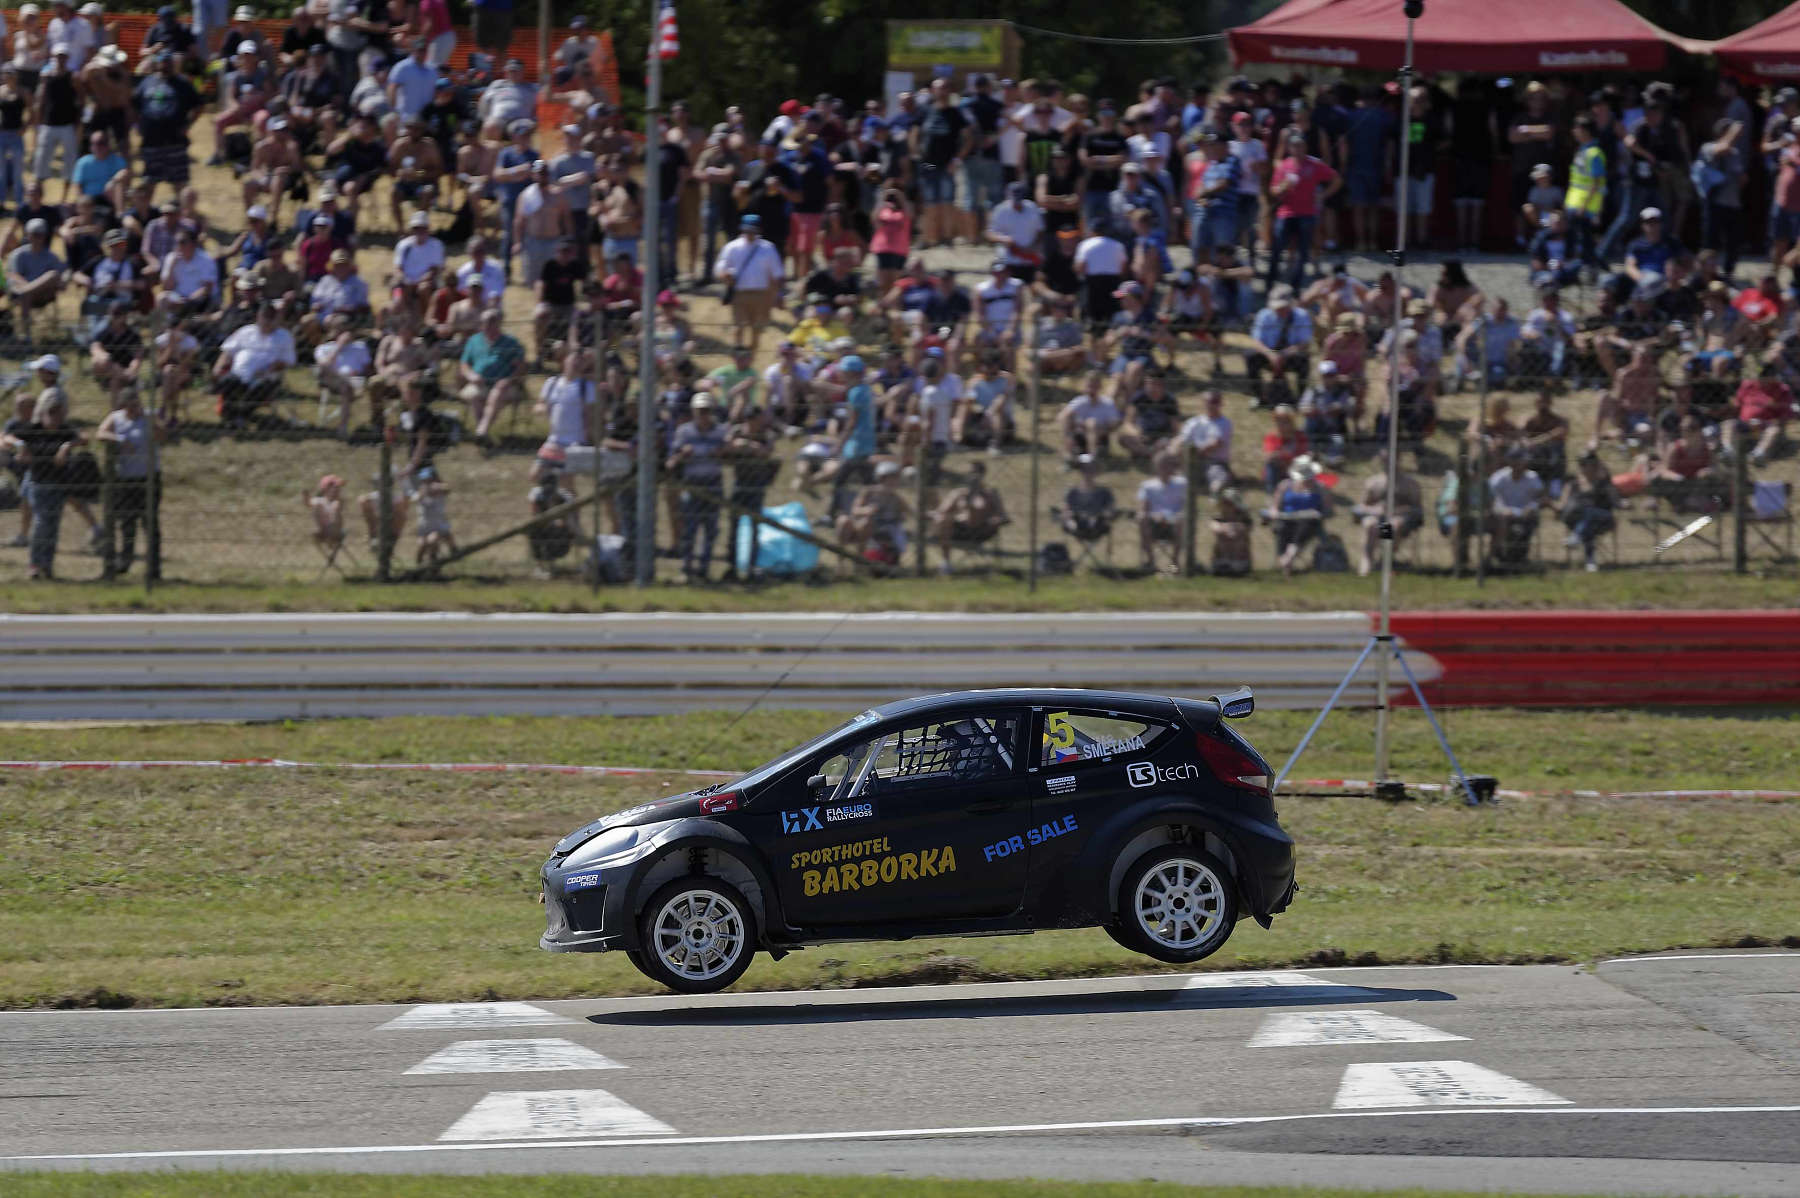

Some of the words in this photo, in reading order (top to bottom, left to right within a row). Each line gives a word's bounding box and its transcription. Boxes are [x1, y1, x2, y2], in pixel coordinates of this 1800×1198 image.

[1048, 712, 1075, 748] 5
[1083, 735, 1146, 759] SMETANA
[1157, 763, 1199, 782] tech
[827, 810, 873, 822] RALLYCROSS
[983, 835, 1025, 863] FOR
[1027, 813, 1079, 846] SALE
[790, 836, 892, 869] SPORTHOTEL
[566, 874, 599, 885] COOPER
[803, 845, 957, 897] BARBORKA
